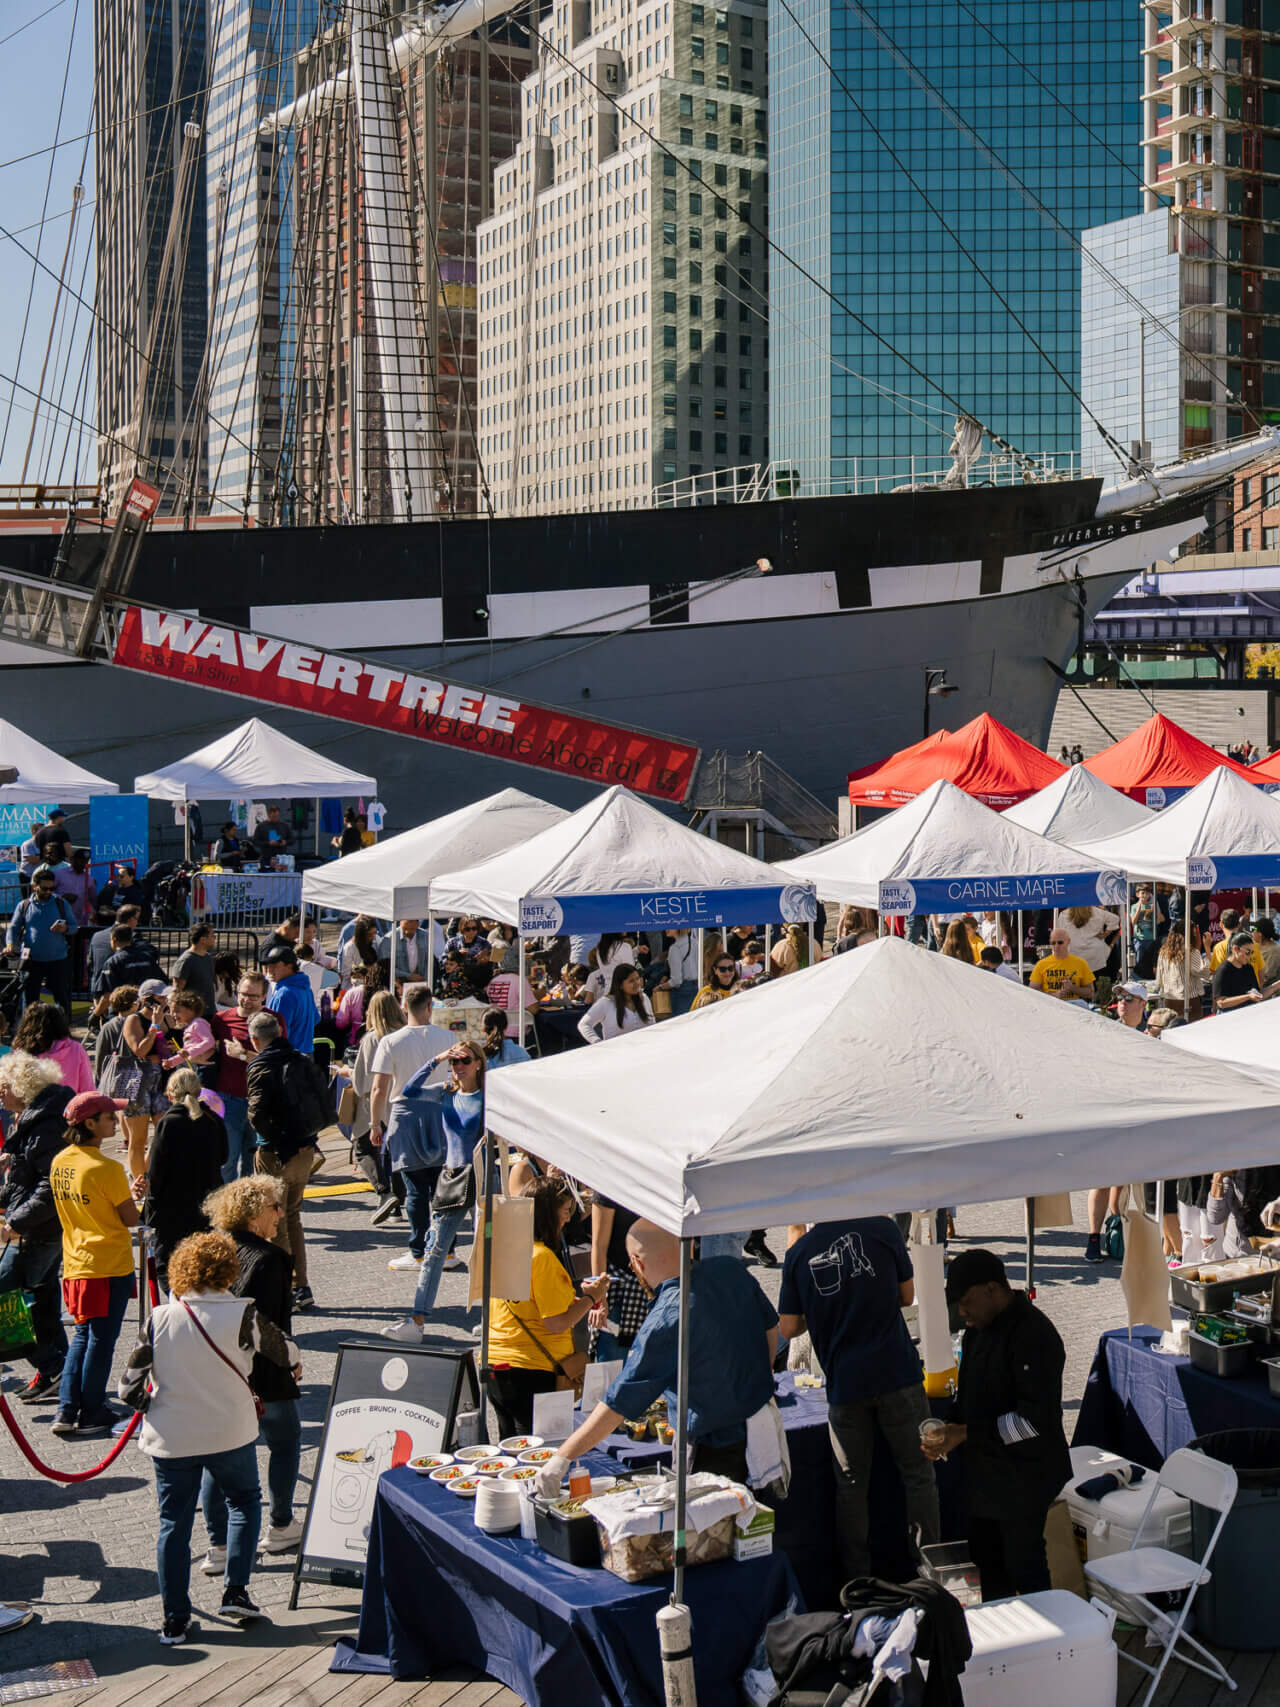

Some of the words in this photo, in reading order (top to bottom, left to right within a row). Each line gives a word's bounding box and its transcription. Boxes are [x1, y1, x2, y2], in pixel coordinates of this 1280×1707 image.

[140, 607, 521, 734] WAVERTREE
[206, 666, 240, 686] Ship
[412, 707, 533, 755] Welcome
[539, 739, 640, 783] Aboard!
[948, 880, 1011, 900] CARNE
[1016, 879, 1065, 897] MARE
[523, 907, 545, 916] TASTE
[640, 892, 708, 916] KESTÉ
[881, 901, 912, 910] SEAPORT
[522, 920, 558, 930] SEAPORT
[335, 1406, 361, 1418] COFFEE
[369, 1405, 397, 1413] BRUNCH
[404, 1409, 441, 1429] COCKTAILS
